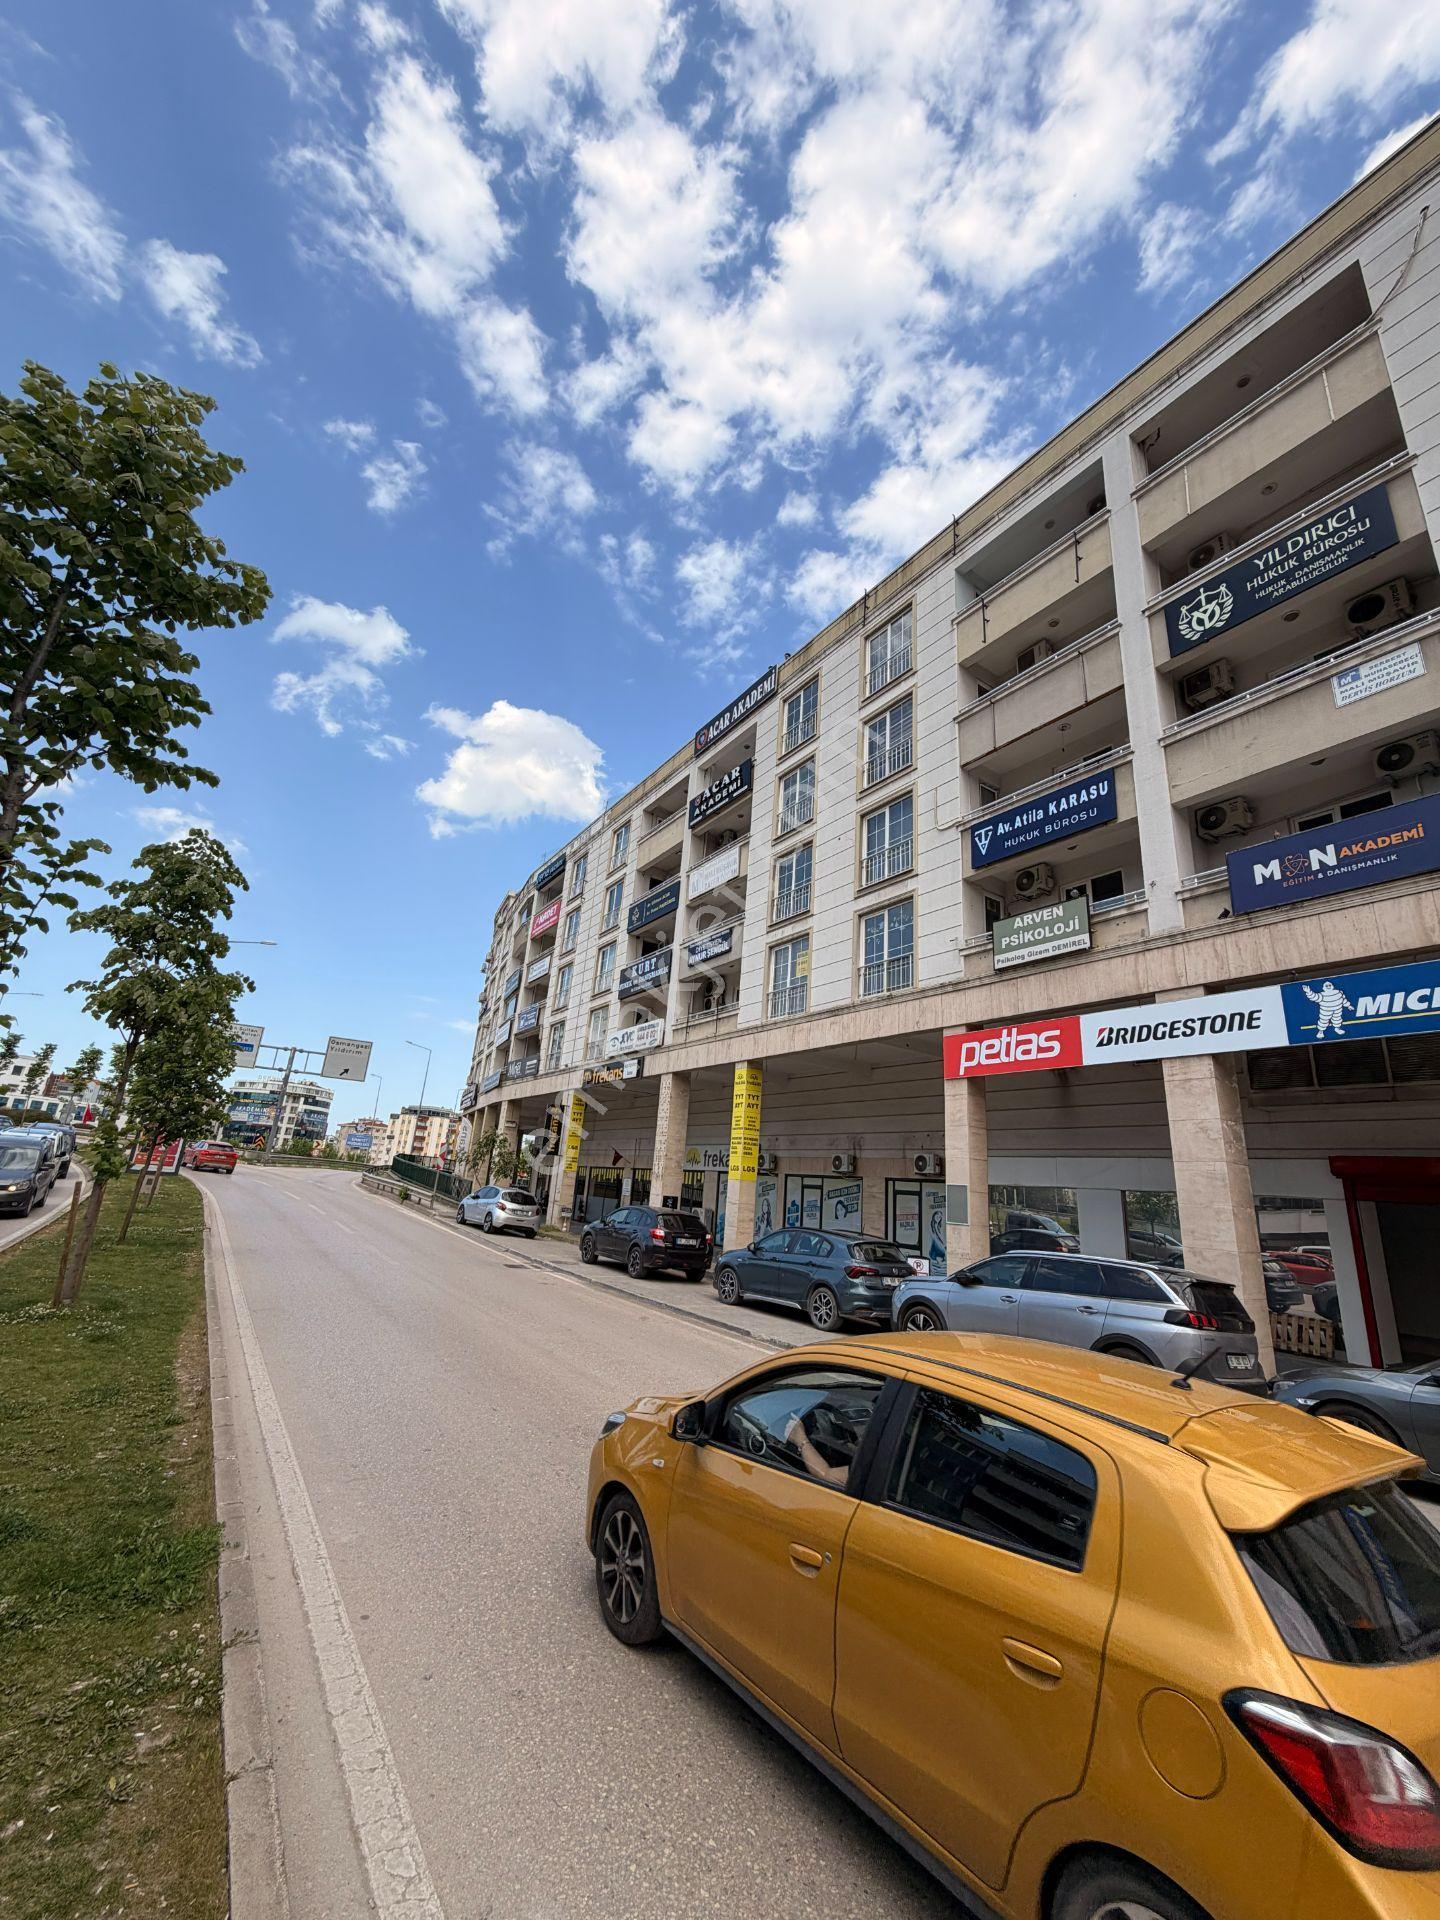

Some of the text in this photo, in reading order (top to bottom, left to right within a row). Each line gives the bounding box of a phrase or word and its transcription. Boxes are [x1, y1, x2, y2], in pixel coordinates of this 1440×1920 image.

[1253, 505, 1356, 570] YILDIRICI
[1246, 518, 1371, 591] HUKUK BÜROSU
[1255, 578, 1287, 599] HUKUK
[1272, 555, 1349, 598] ARABULUCULUK
[1375, 667, 1417, 689] HORZUM
[708, 670, 775, 741] ACAR AKADEMİ
[694, 778, 742, 817] AKADEMİ
[702, 766, 741, 800] ACAR
[997, 780, 1109, 836] Av. Atila KARASU
[1004, 807, 1097, 849] HUKUK BÜROSU
[1339, 823, 1425, 859] AKADEMİ
[1327, 854, 1398, 877] DANIŞMANLIK
[1013, 905, 1064, 929] ARVEN
[1001, 916, 1080, 949] PSİKOLOJİ
[688, 949, 706, 965] AYNUR
[996, 953, 1026, 966] Psikolog
[1051, 938, 1088, 953] DEMİREL
[631, 958, 657, 978] KURT
[330, 1047, 363, 1056] Yıldırım
[331, 1040, 371, 1050] Osmangazi
[959, 1009, 1263, 1075] petlas BRIDGESTONE
[593, 1066, 623, 1084] frekans
[747, 1093, 760, 1101] TYT
